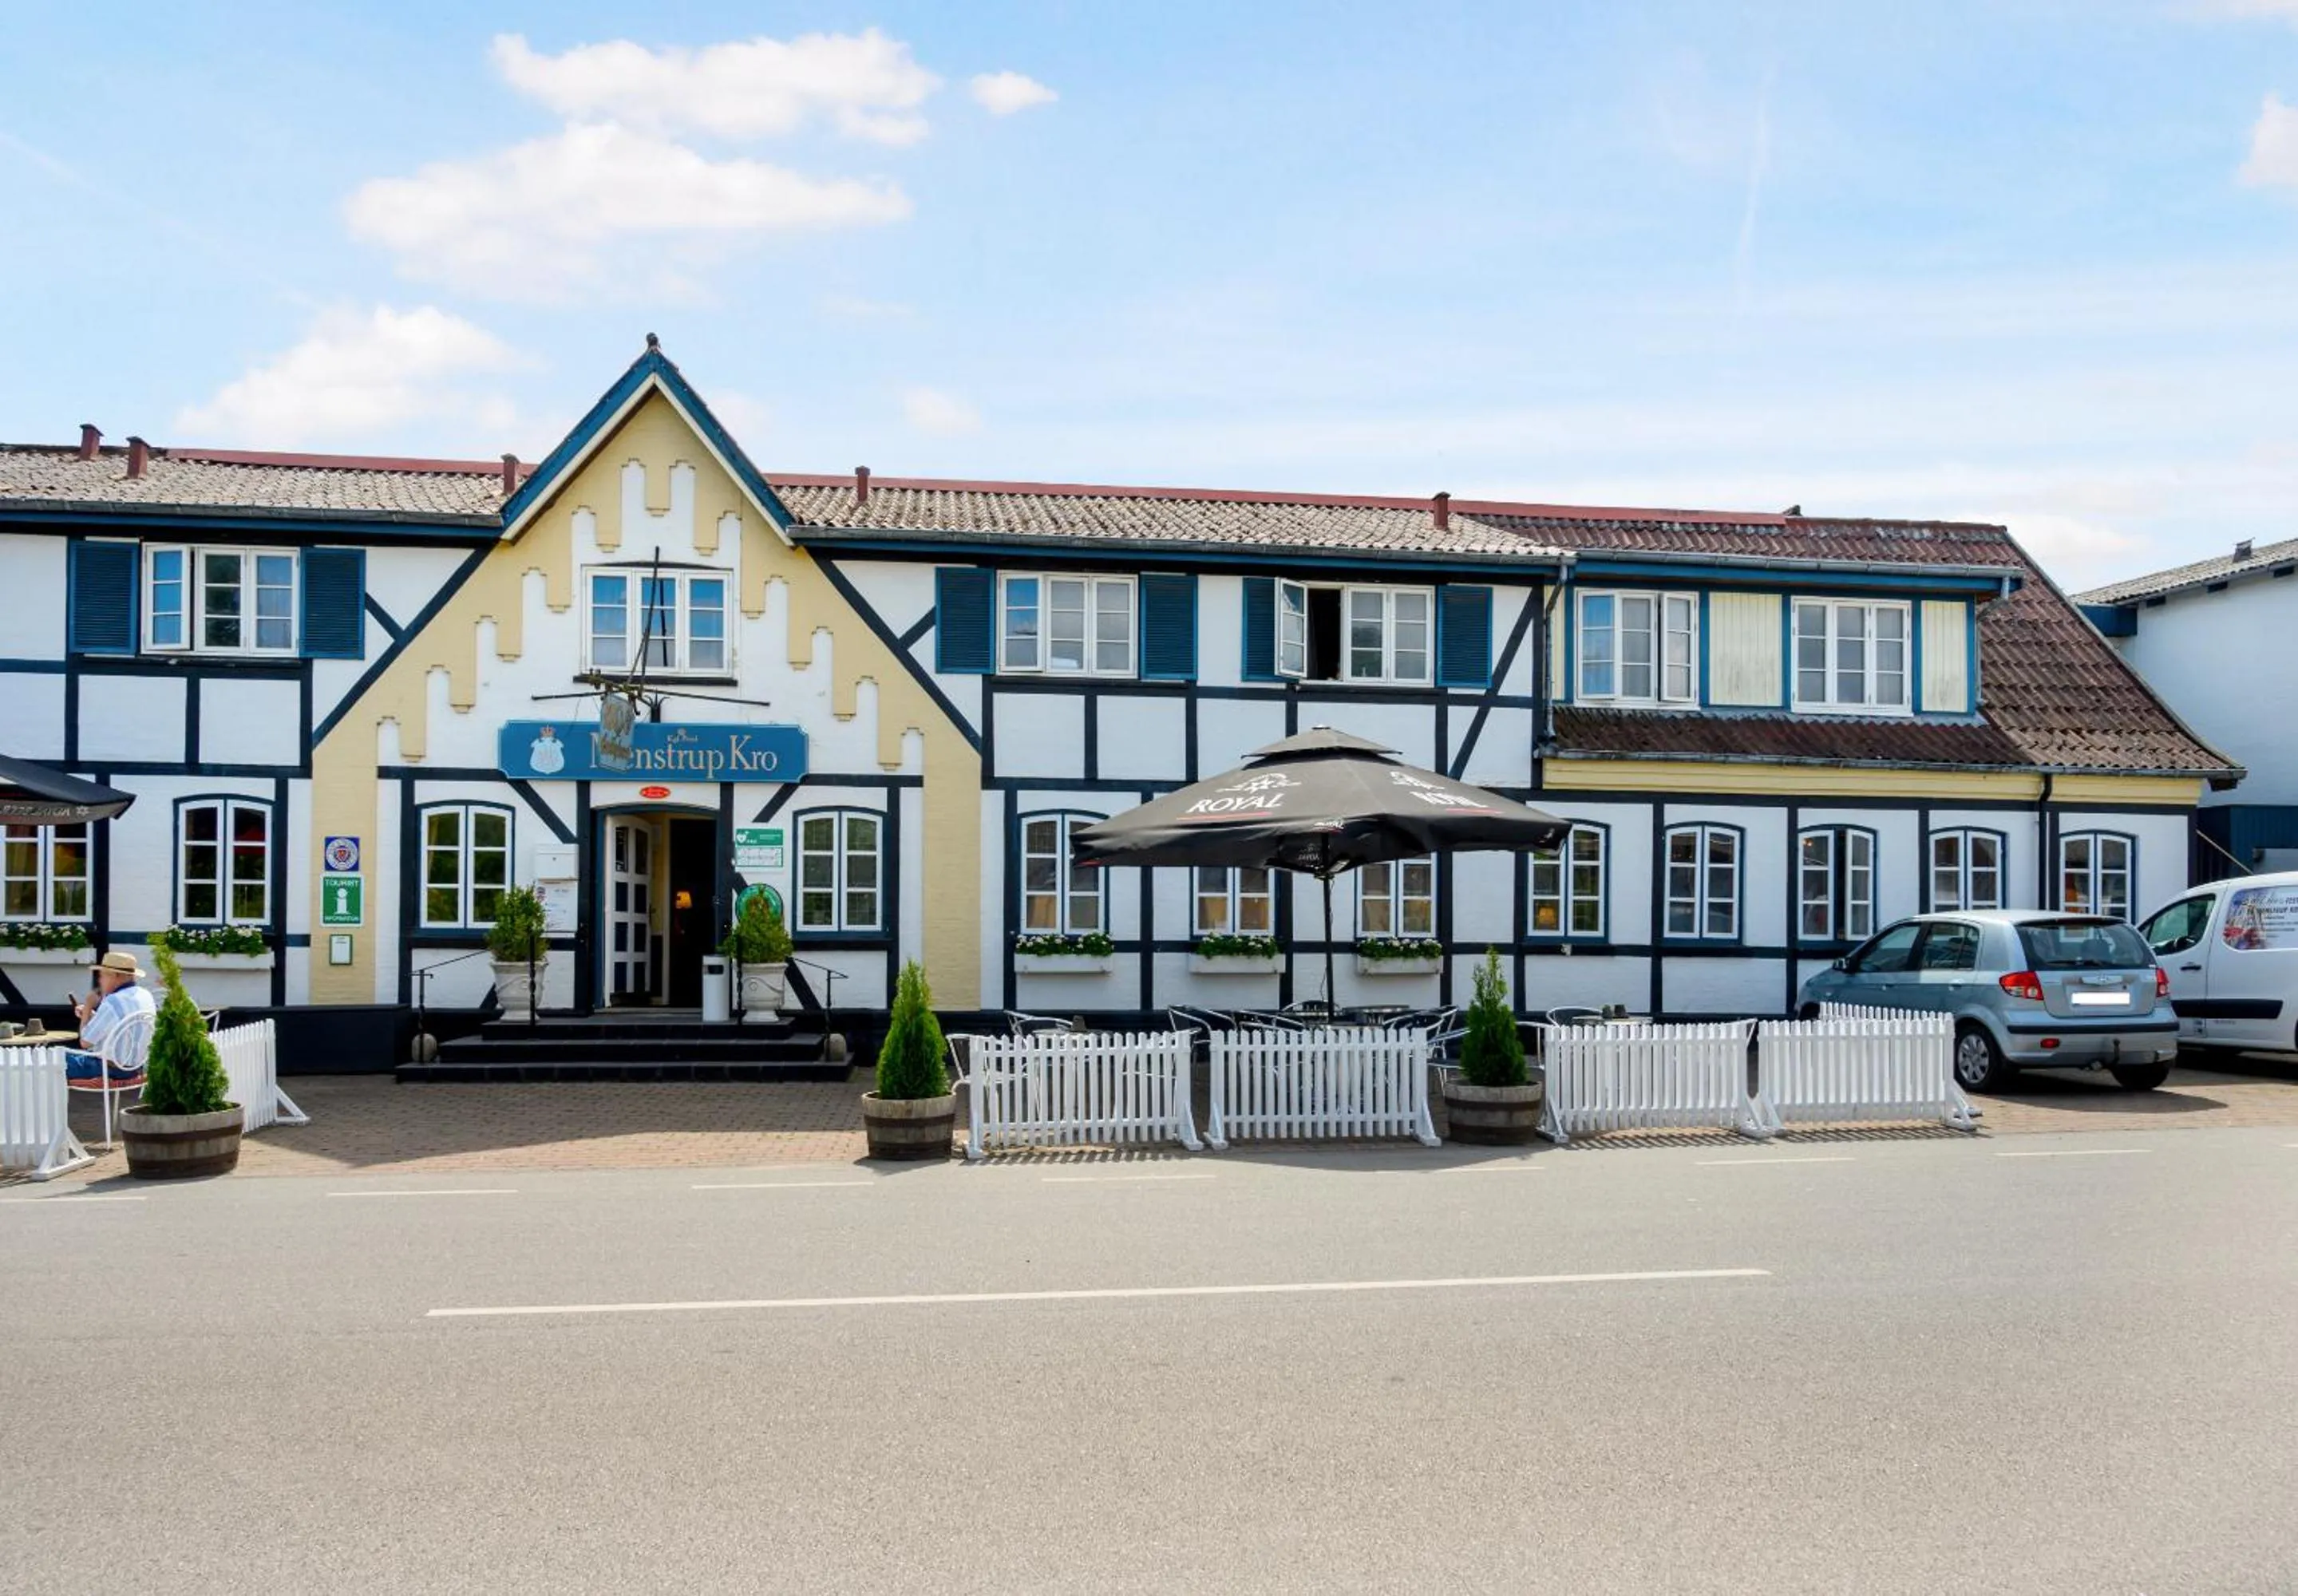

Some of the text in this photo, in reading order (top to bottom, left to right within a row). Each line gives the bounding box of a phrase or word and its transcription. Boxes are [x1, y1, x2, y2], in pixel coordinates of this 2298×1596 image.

[590, 732, 725, 779] nstrup
[729, 734, 777, 771] Kro
[1189, 792, 1283, 814] ROYAL
